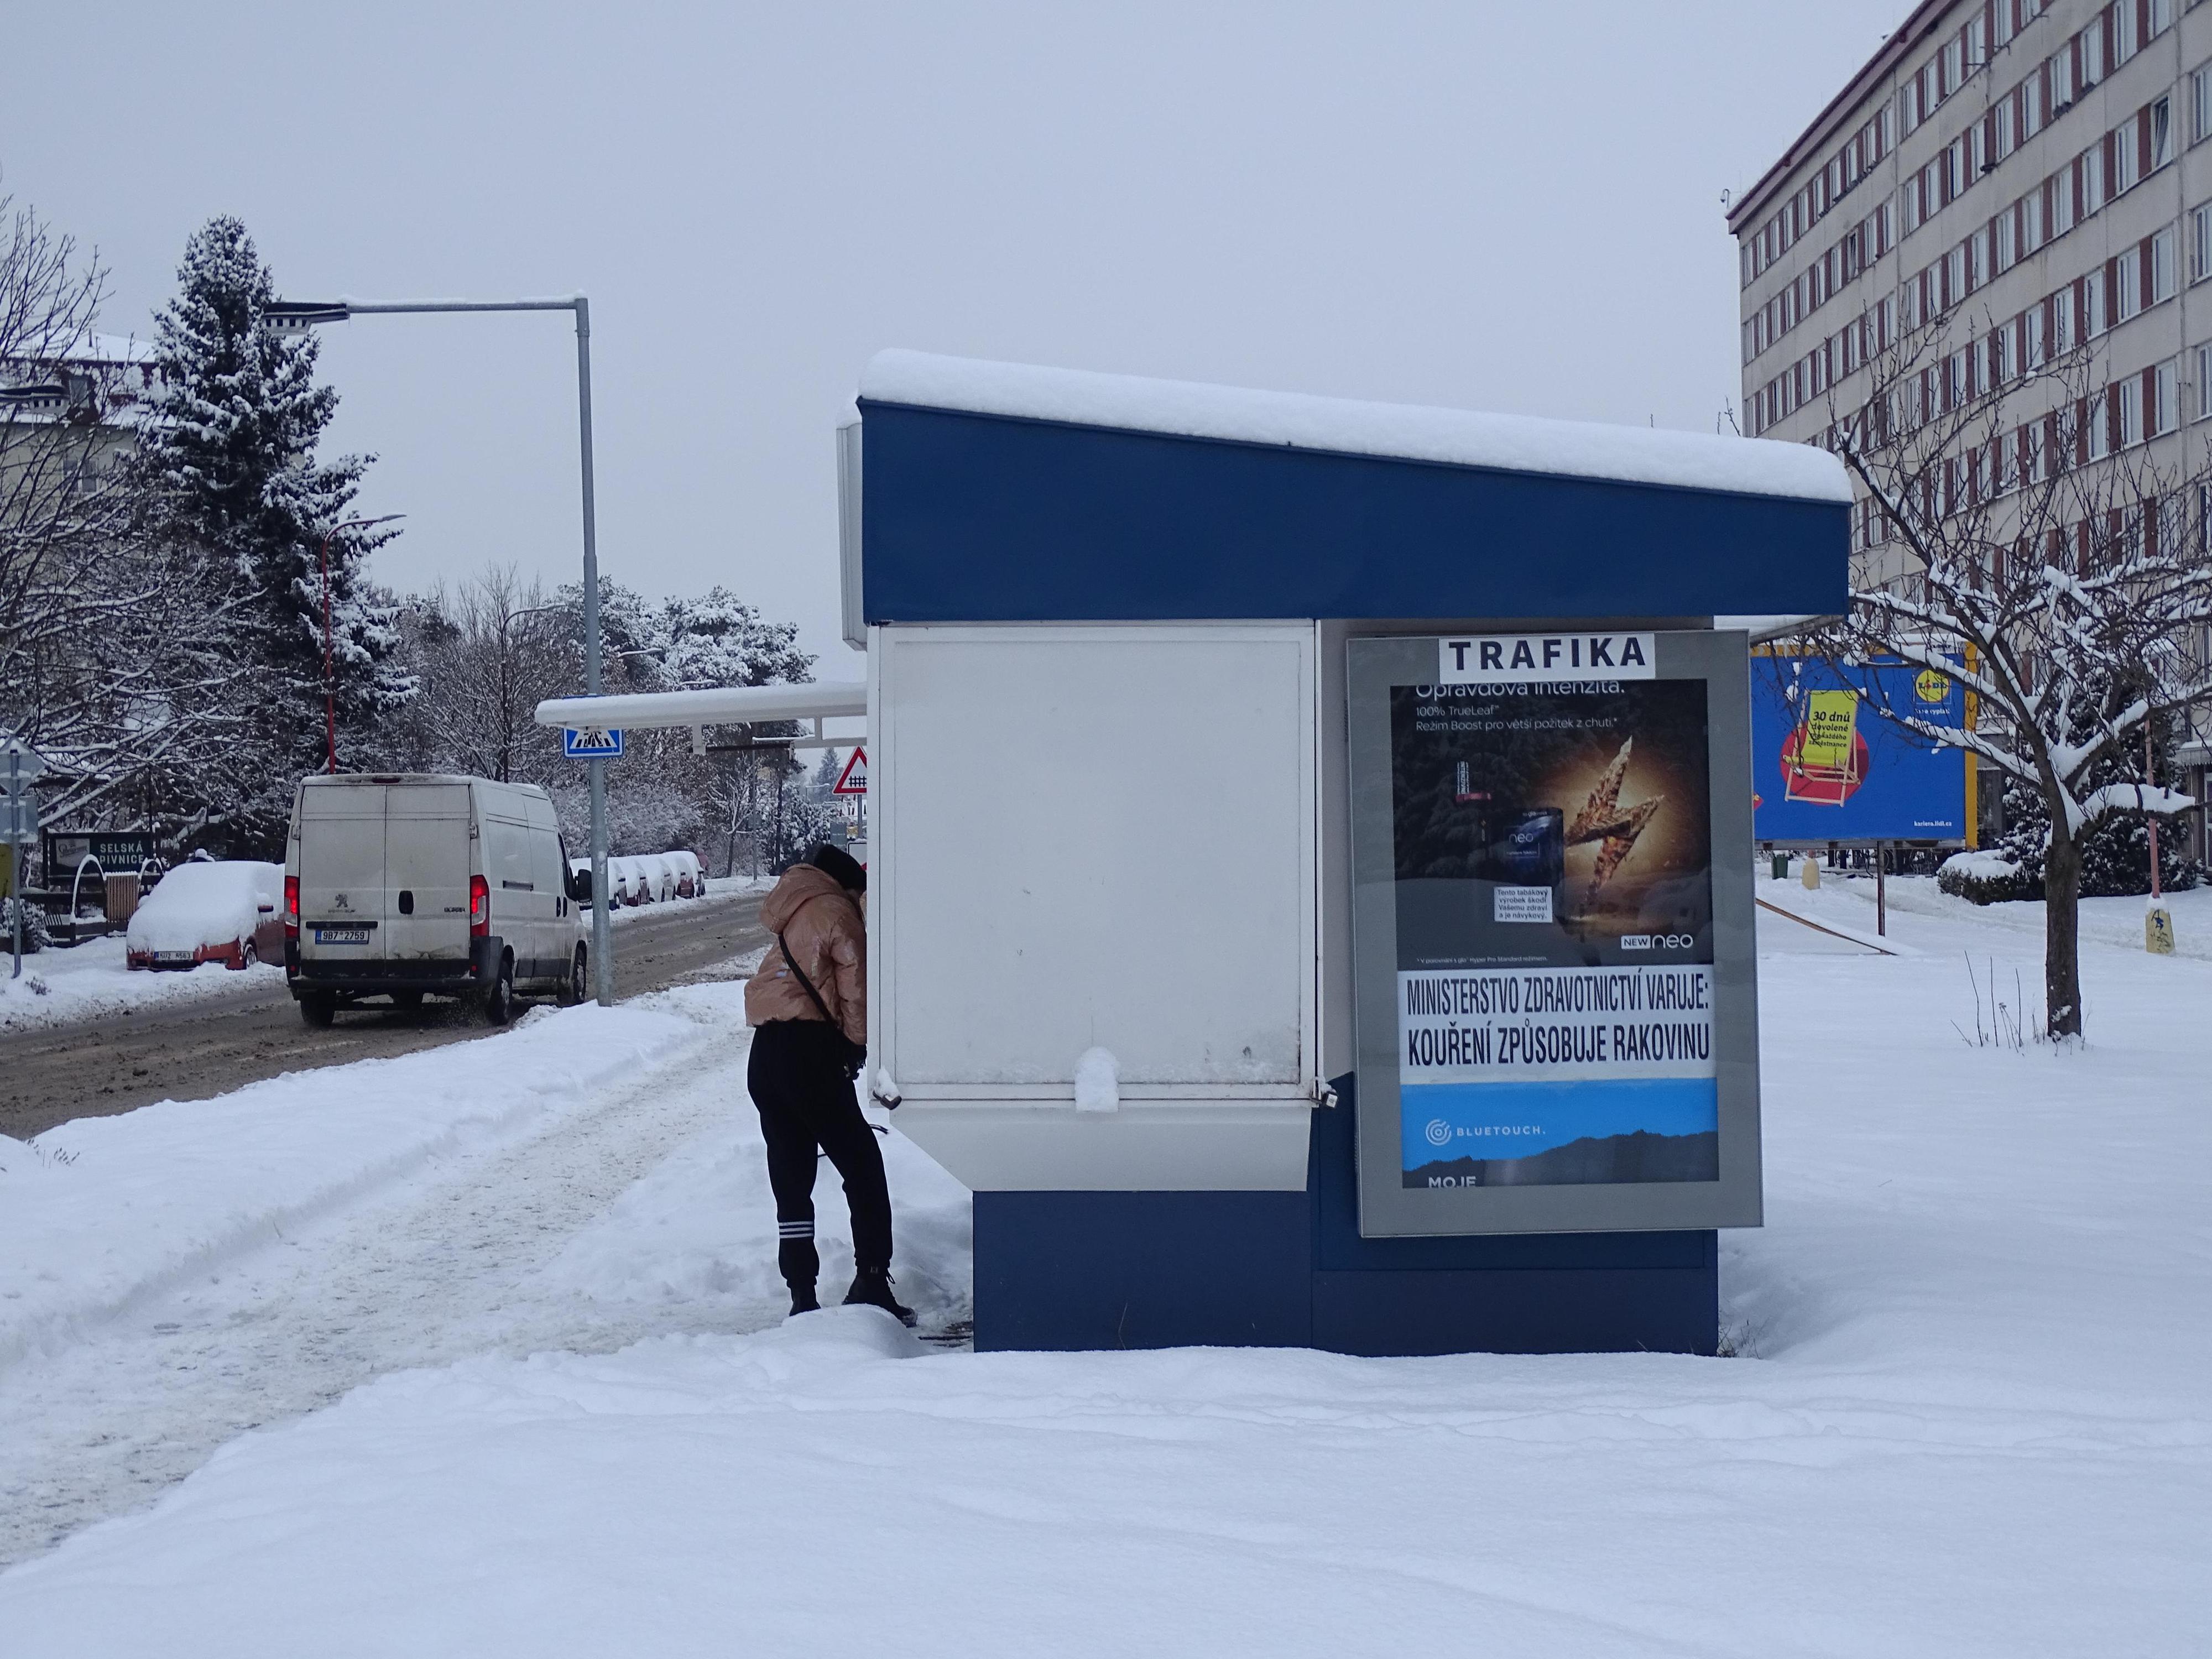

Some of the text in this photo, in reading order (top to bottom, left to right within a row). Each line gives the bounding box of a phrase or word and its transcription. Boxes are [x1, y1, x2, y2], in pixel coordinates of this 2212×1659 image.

[1448, 637, 1646, 670] TRAFIKA
[1416, 707, 1445, 716] 100%
[1813, 711, 1850, 722] 30 dnů
[1416, 720, 1448, 731] Režim
[1451, 721, 1482, 730] Boost
[1485, 721, 1504, 732] pro
[1507, 718, 1532, 729] větší
[1535, 718, 1573, 730] požitek
[1509, 833, 1533, 843] neo
[100, 840, 143, 853] SELSKÁ
[100, 854, 144, 864] PIVNICE
[1517, 889, 1548, 897] tabákový
[323, 931, 365, 940] 9B7 2759
[1624, 934, 1693, 949] NEW neo
[1407, 968, 1709, 1015] MINISTERSTVO ZDRAVOTNICTVÍ VARUJE:
[1408, 1018, 1710, 1066] KOUŘENÍ ZPŮSOBUJE RAKOVINU
[1456, 1125, 1546, 1137] BLUETOUCH.
